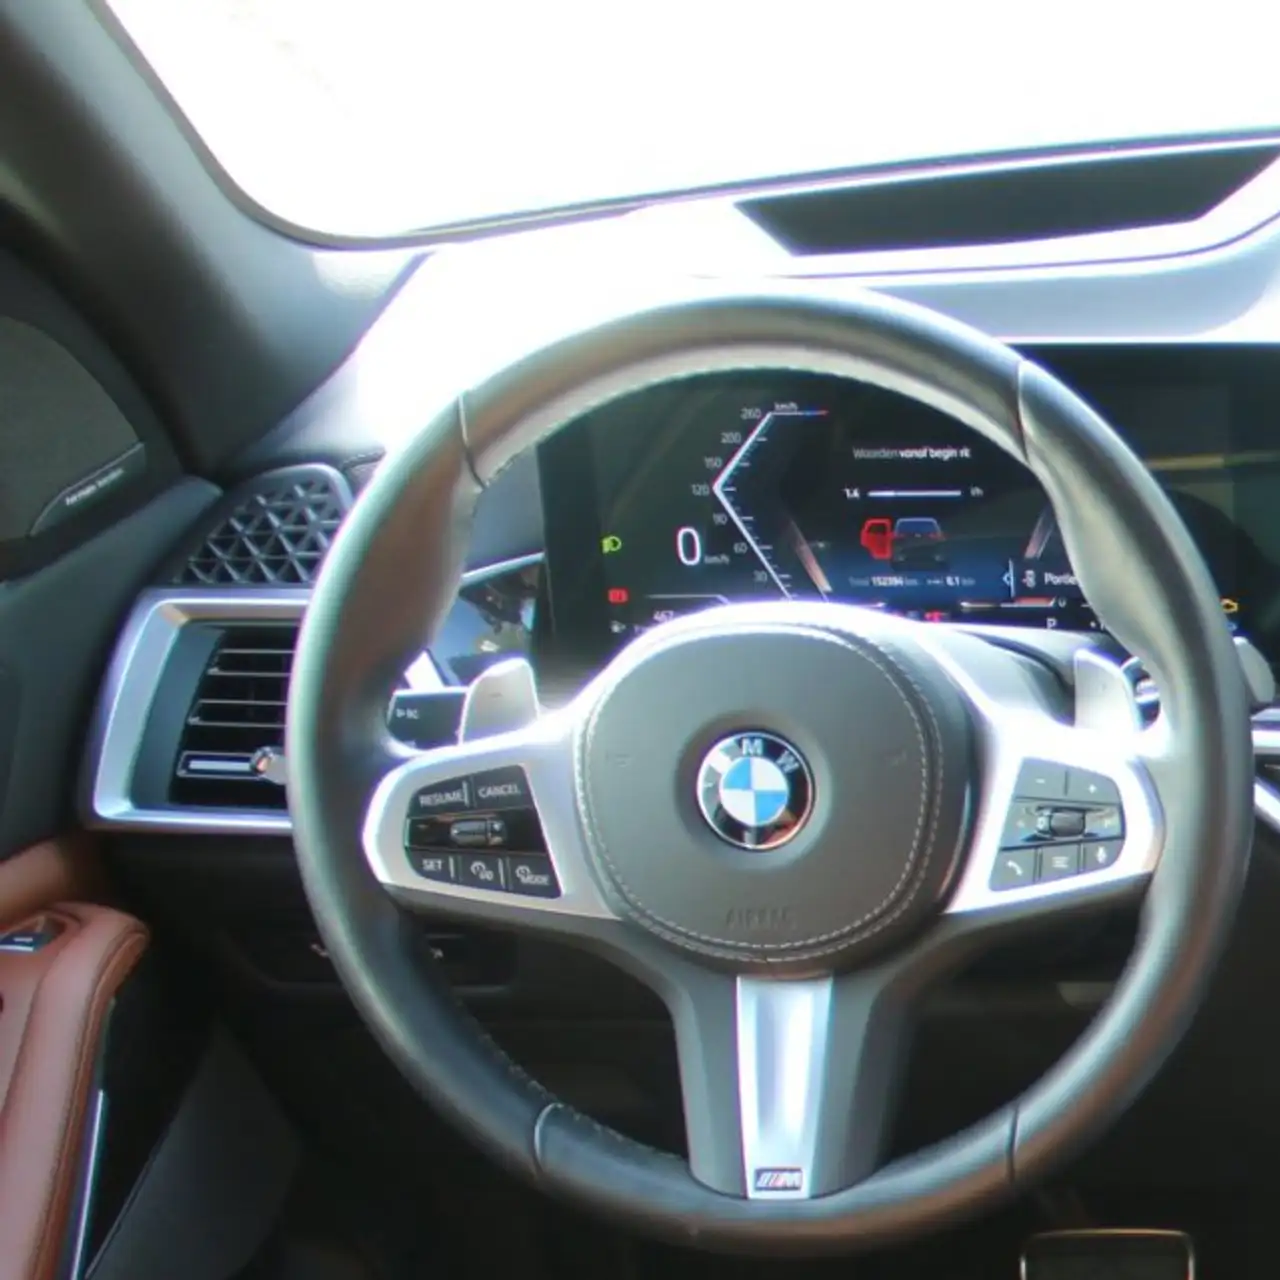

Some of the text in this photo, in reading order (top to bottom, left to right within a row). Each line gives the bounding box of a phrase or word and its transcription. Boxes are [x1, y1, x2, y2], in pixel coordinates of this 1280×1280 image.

[721, 432, 741, 443] 200
[929, 446, 957, 460] begin
[677, 527, 701, 566] 0
[478, 784, 520, 798] CANCEL
[419, 790, 463, 807] RESUME
[422, 860, 443, 871] SET
